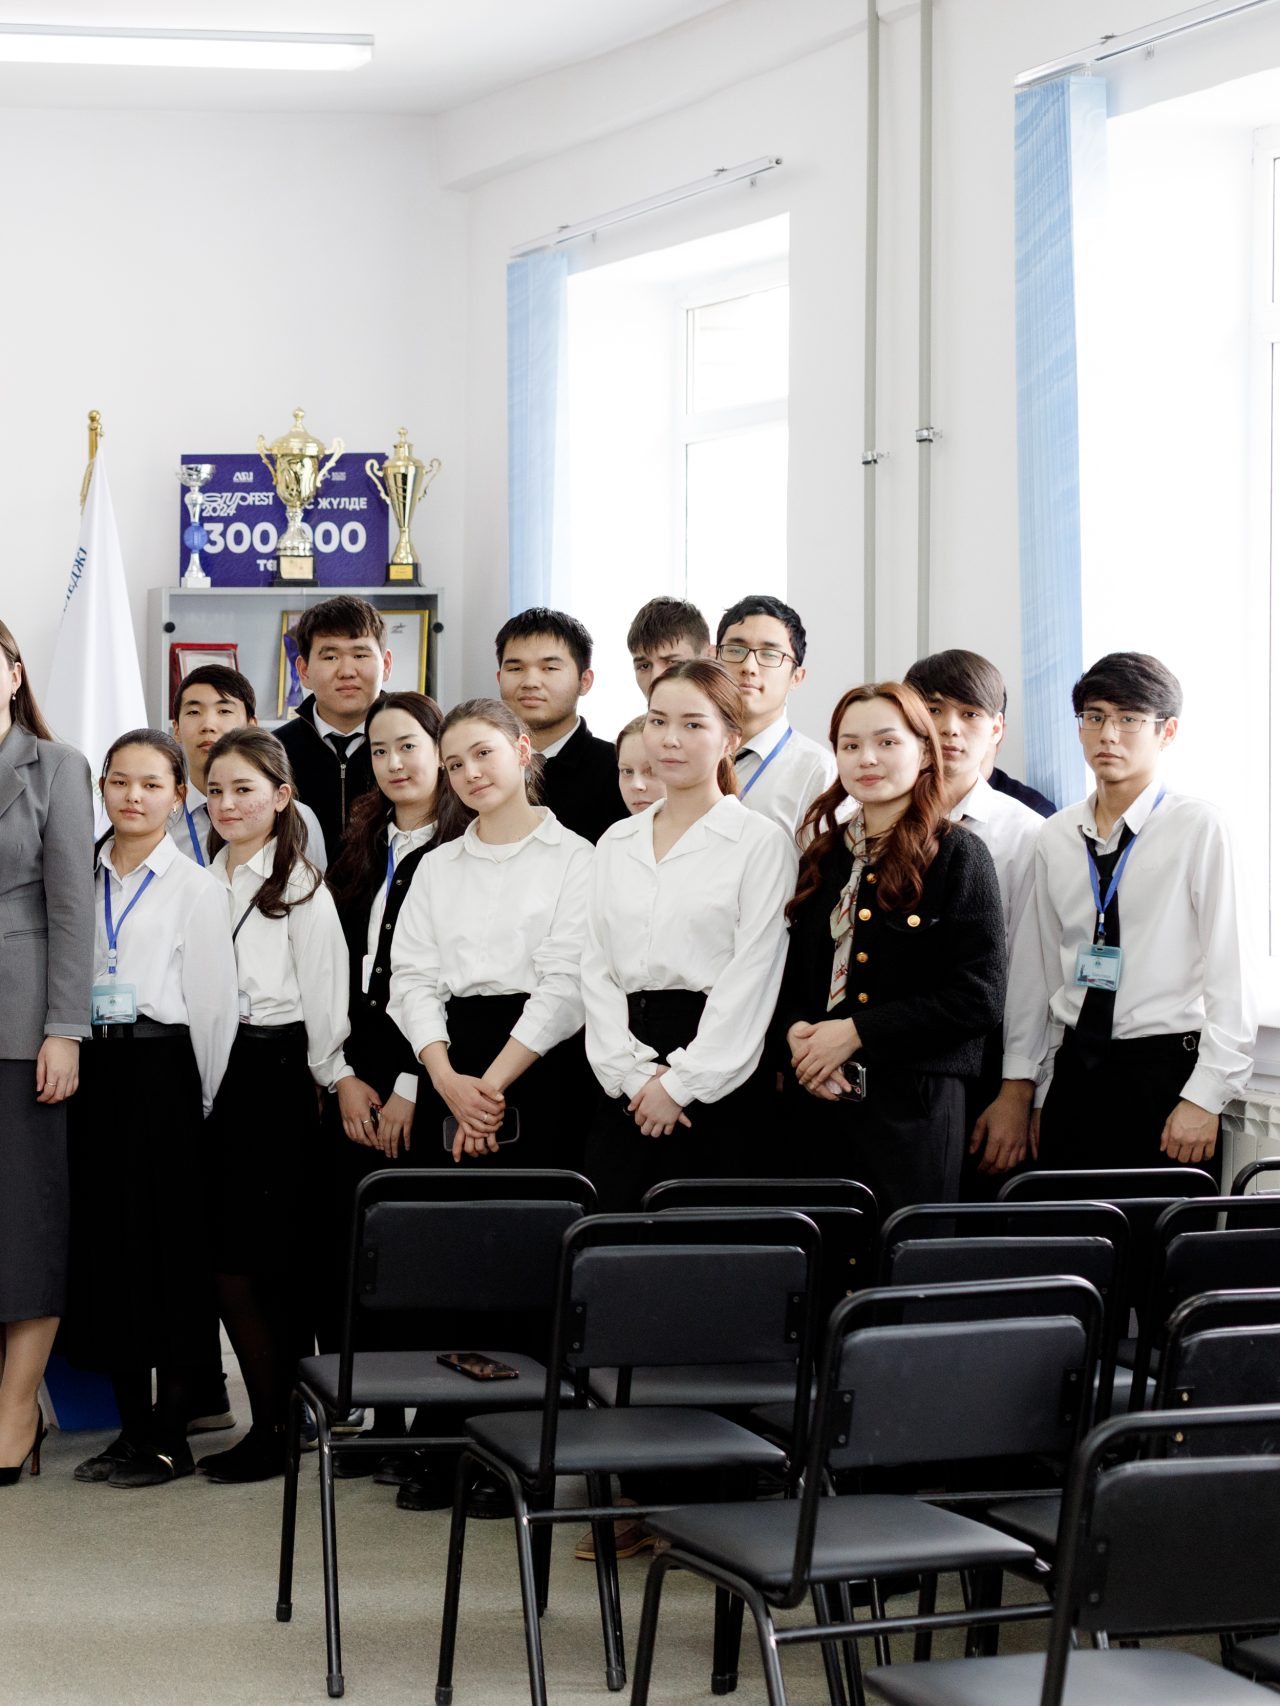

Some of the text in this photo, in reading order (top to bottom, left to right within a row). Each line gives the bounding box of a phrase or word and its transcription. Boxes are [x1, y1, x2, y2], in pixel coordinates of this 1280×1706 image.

[202, 503, 236, 517] 2024
[317, 497, 368, 511] ЖҮЛДЕ
[203, 521, 278, 554] 300
